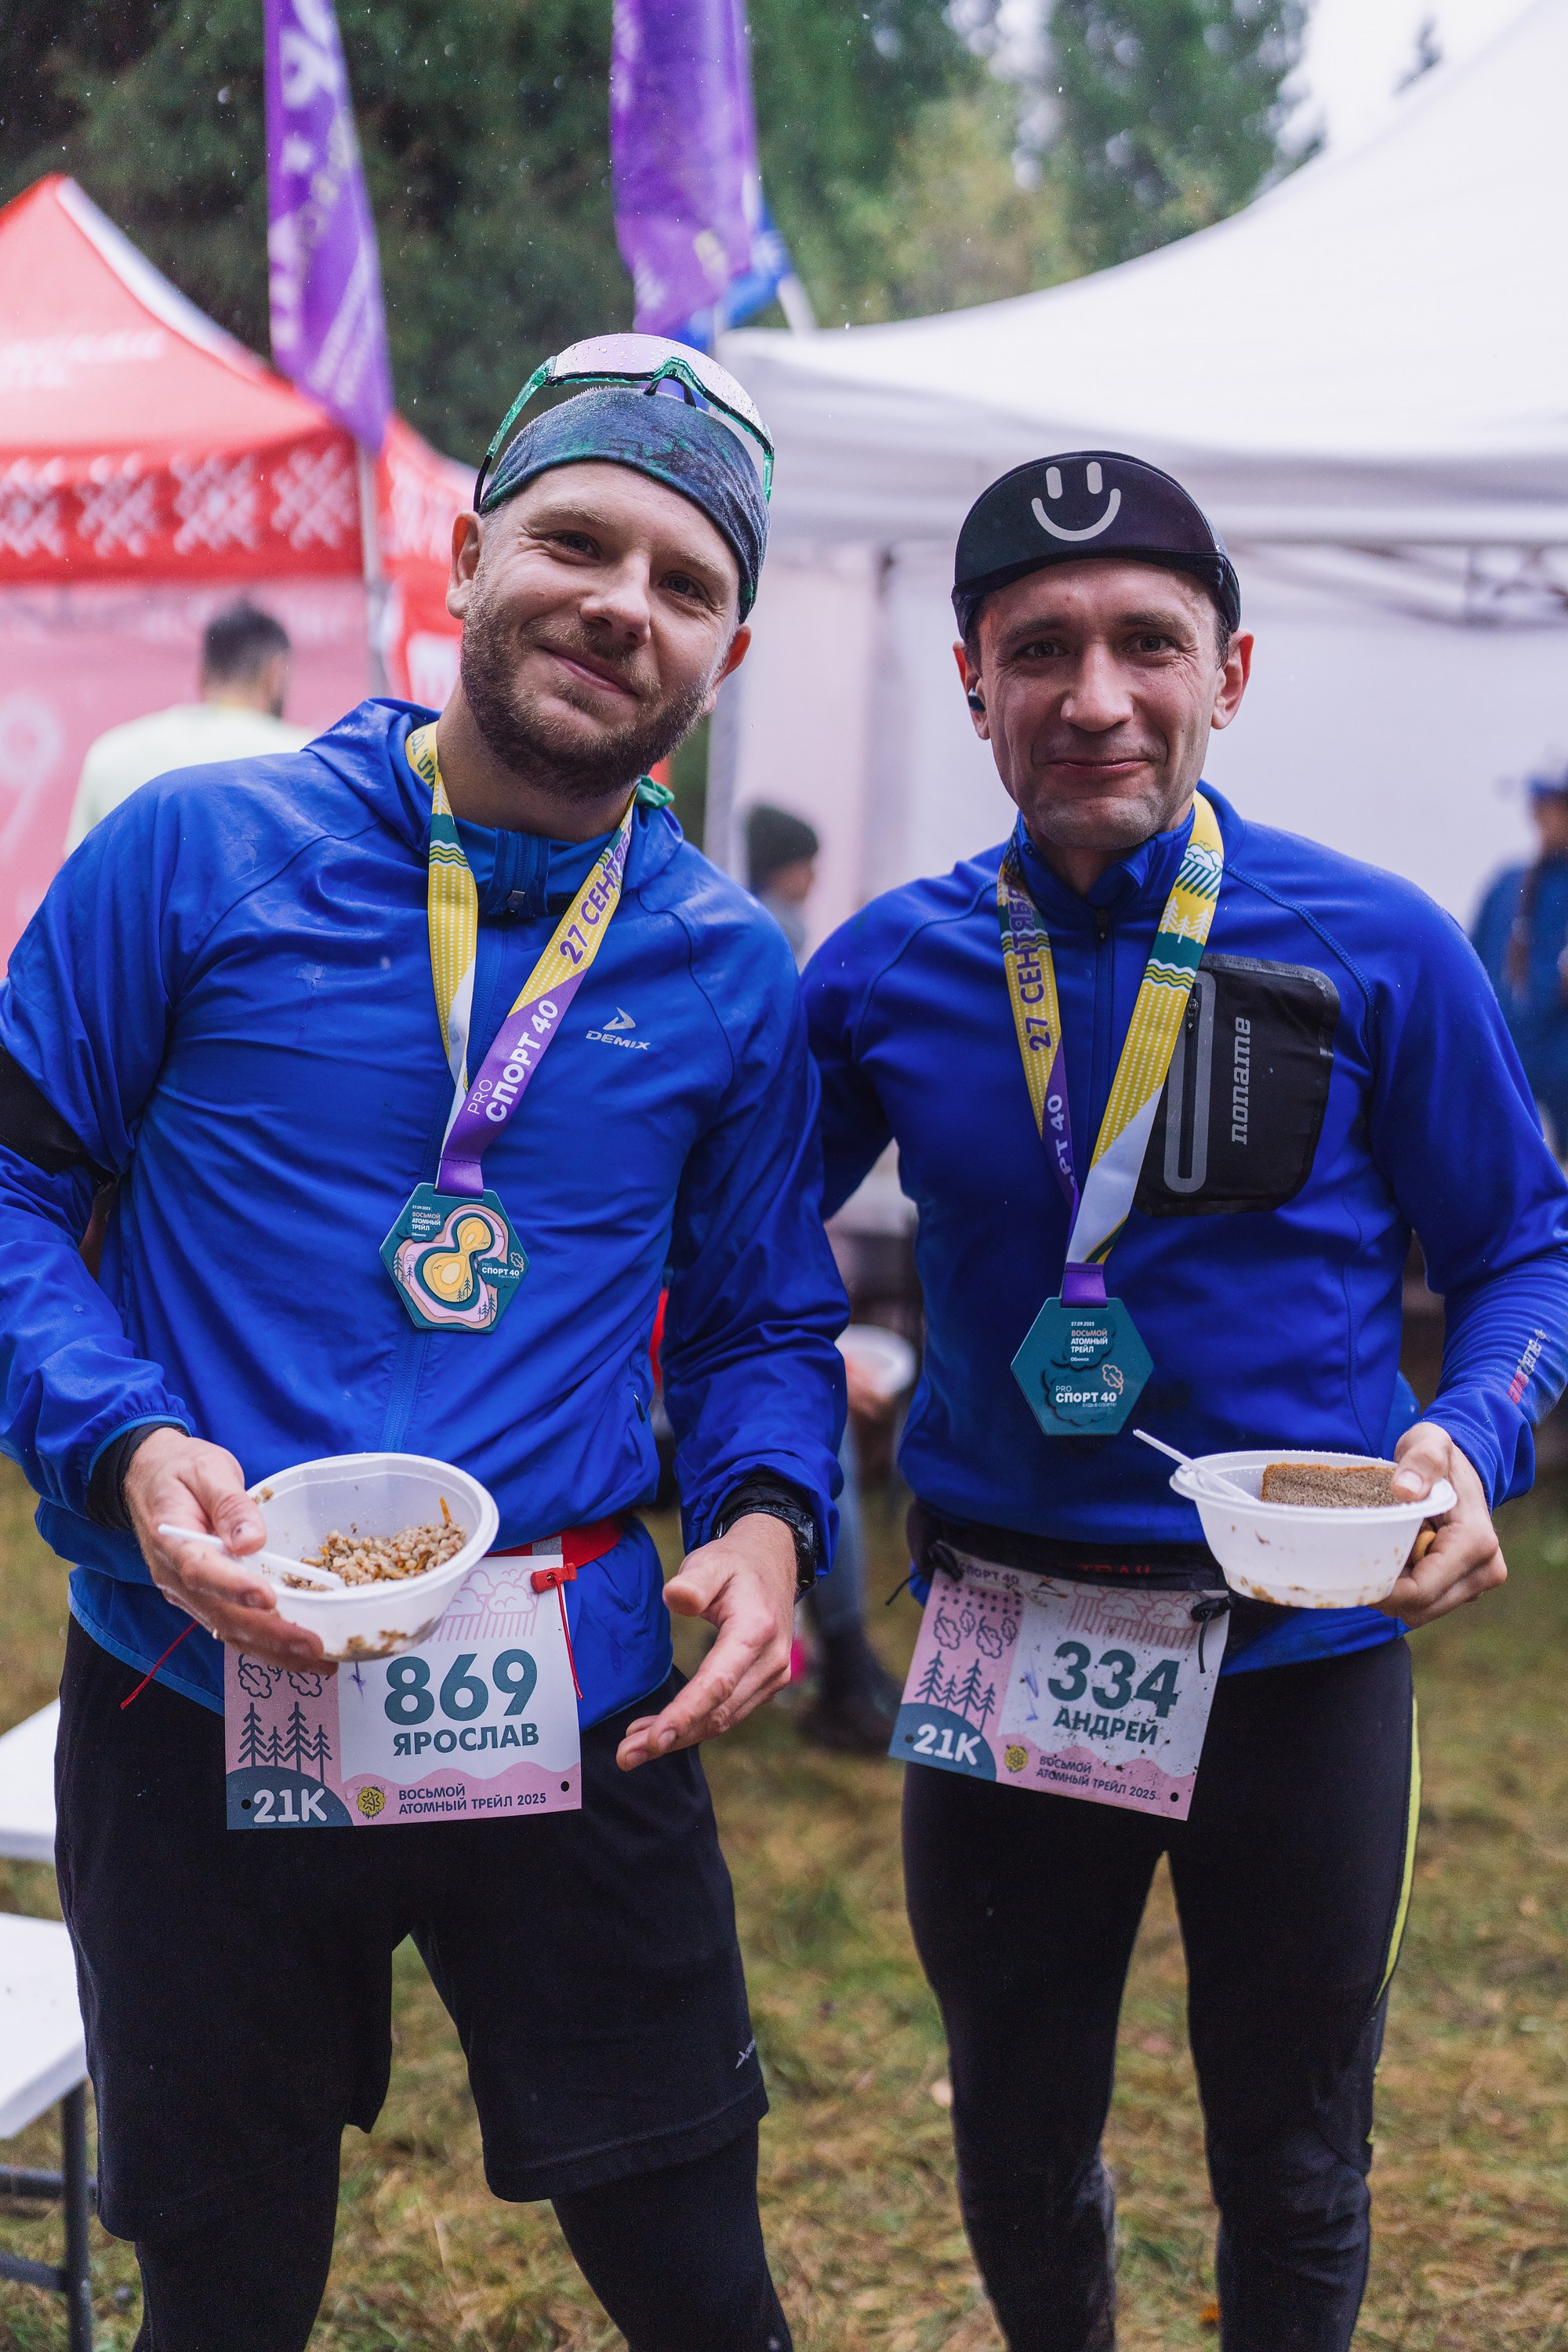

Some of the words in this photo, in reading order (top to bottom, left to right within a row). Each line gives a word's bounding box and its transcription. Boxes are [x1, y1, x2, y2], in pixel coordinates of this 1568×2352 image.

[559, 925, 590, 965] 27
[581, 821, 632, 925] СЕНТЯБ
[585, 1029, 652, 1051] DEMIX
[1029, 1017, 1052, 1052] 27
[485, 1029, 540, 1123] СПОРТ
[531, 1000, 559, 1036] 40
[467, 1079, 493, 1116] PRO
[1232, 1017, 1251, 1145] noname
[1047, 1094, 1065, 1131] 40
[481, 1267, 509, 1276] СПОРТ
[1071, 1328, 1108, 1337] ВОСЬМОЙ
[1071, 1345, 1094, 1353] ТРЕЙЛ
[1055, 1392, 1098, 1403] СПОРТ
[1101, 1392, 1117, 1403] 40
[384, 1648, 538, 1726] 869
[1047, 1641, 1180, 1719] 334
[393, 1722, 539, 1756] ЯРОСЛАВ
[1052, 1707, 1159, 1746] АНДРЕЙ
[1040, 1755, 1091, 1774] ВОСЬМОЙ
[398, 1784, 465, 1800] ВОСЬМОЙ
[1036, 1768, 1090, 1788] АТОМНЫЙ
[1092, 1778, 1127, 1794] ТРЕЙЛ
[1129, 1786, 1156, 1801] 2025
[398, 1797, 466, 1814] АТОМНЫЙ
[471, 1795, 512, 1809] ТРЕЙЛ
[517, 1793, 546, 1805] 2025
